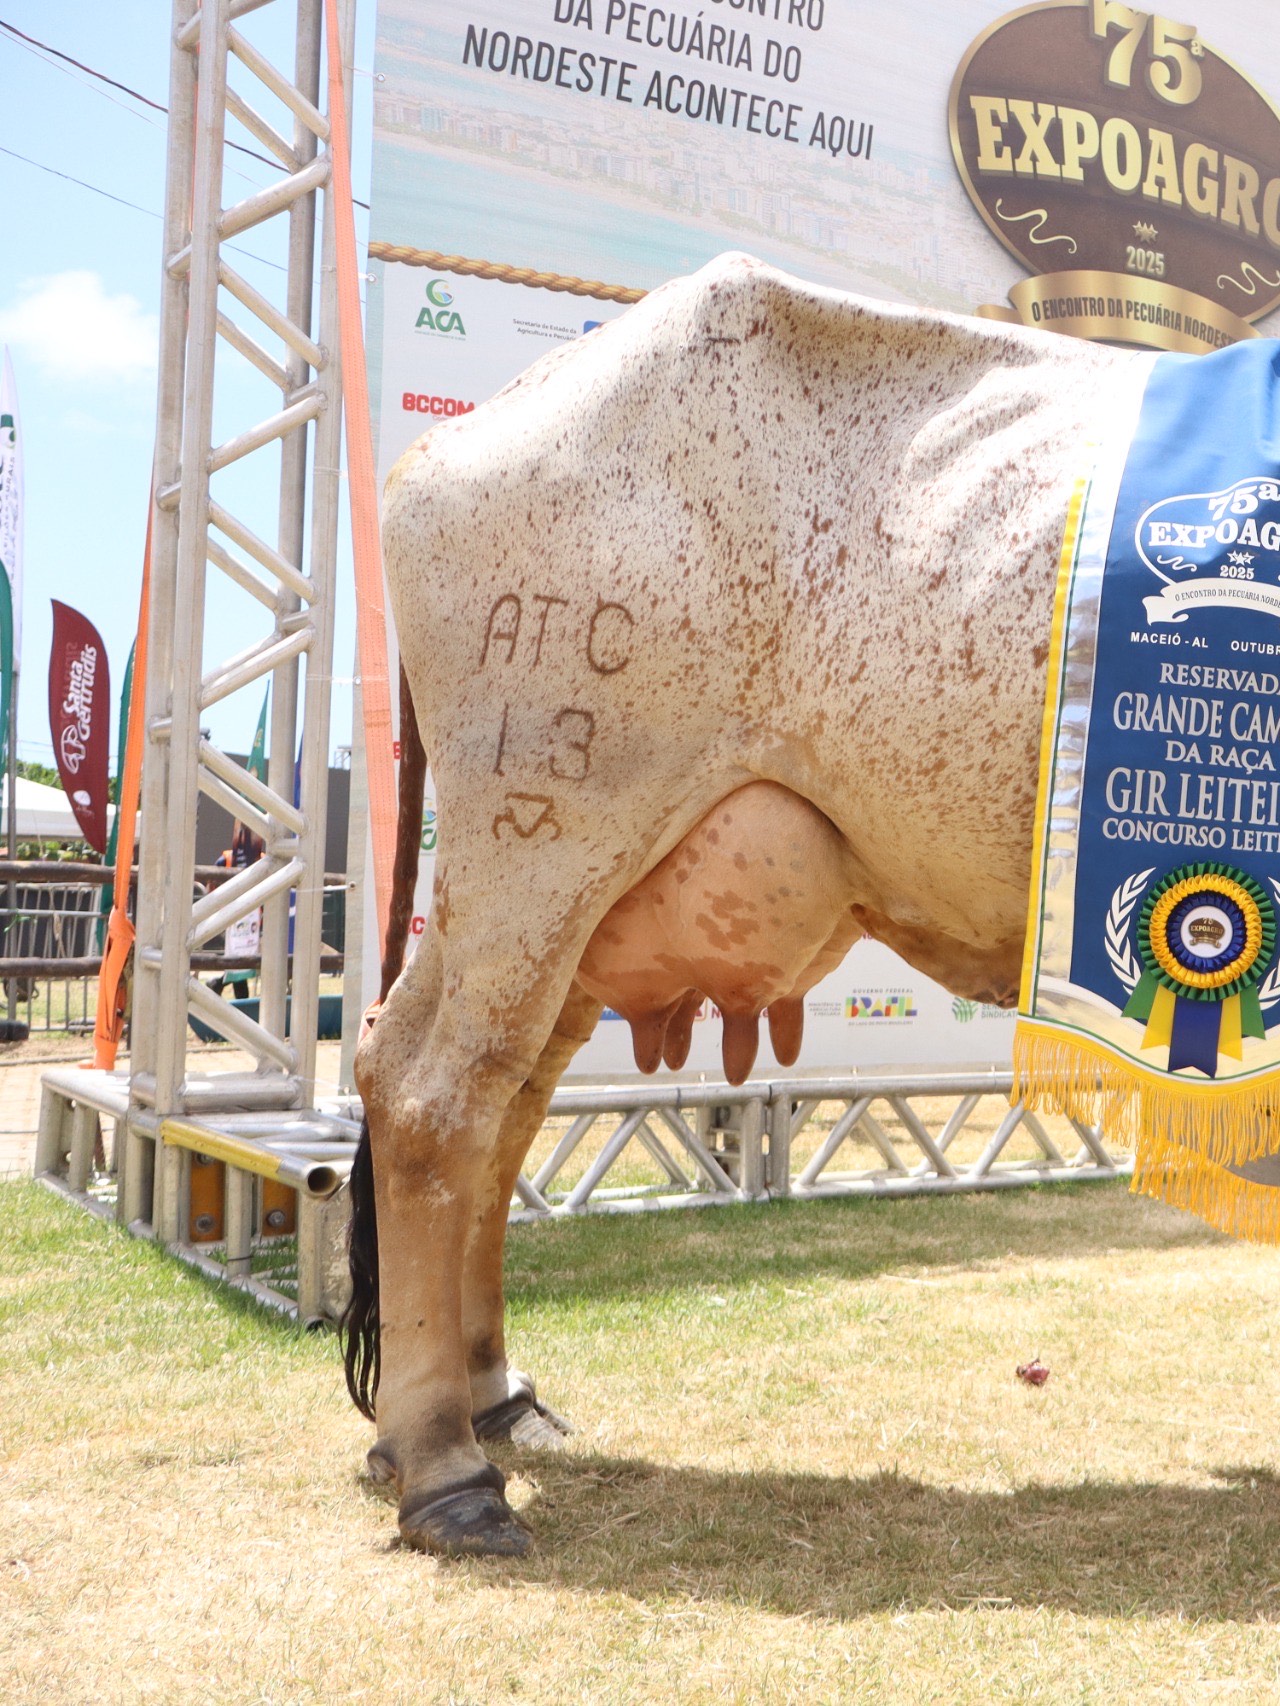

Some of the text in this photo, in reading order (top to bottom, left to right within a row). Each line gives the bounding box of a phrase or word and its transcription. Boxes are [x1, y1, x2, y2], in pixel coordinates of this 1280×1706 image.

[553, 0, 802, 83] DA PECUÁRIA DO
[461, 24, 874, 161] NORDESTE ACONTECE AQUI
[1126, 245, 1165, 276] 2025
[414, 307, 467, 336] ACA
[513, 318, 541, 328] Secretaria
[550, 325, 568, 333] Estado
[1032, 301, 1042, 322] O
[1043, 297, 1105, 320] ENCONTRO
[1107, 298, 1124, 319] DA
[1126, 303, 1182, 331] PECUÁRIA
[517, 327, 548, 338] Agricultura
[1219, 565, 1255, 580] 2025
[1181, 588, 1217, 601] ENCONTRO
[1219, 588, 1227, 597] DA
[479, 593, 635, 675] ATC
[1130, 631, 1181, 646] MACEIÓ
[1192, 637, 1209, 649] AL
[63, 660, 83, 718] Santa
[78, 643, 97, 741] Gertrudis
[1113, 691, 1224, 738] GRANDE
[1165, 740, 1276, 774] DA RAÇA
[1105, 767, 1170, 816] GIR
[1102, 817, 1226, 848] CONCURSO
[981, 1010, 1018, 1018] SINDICAT
